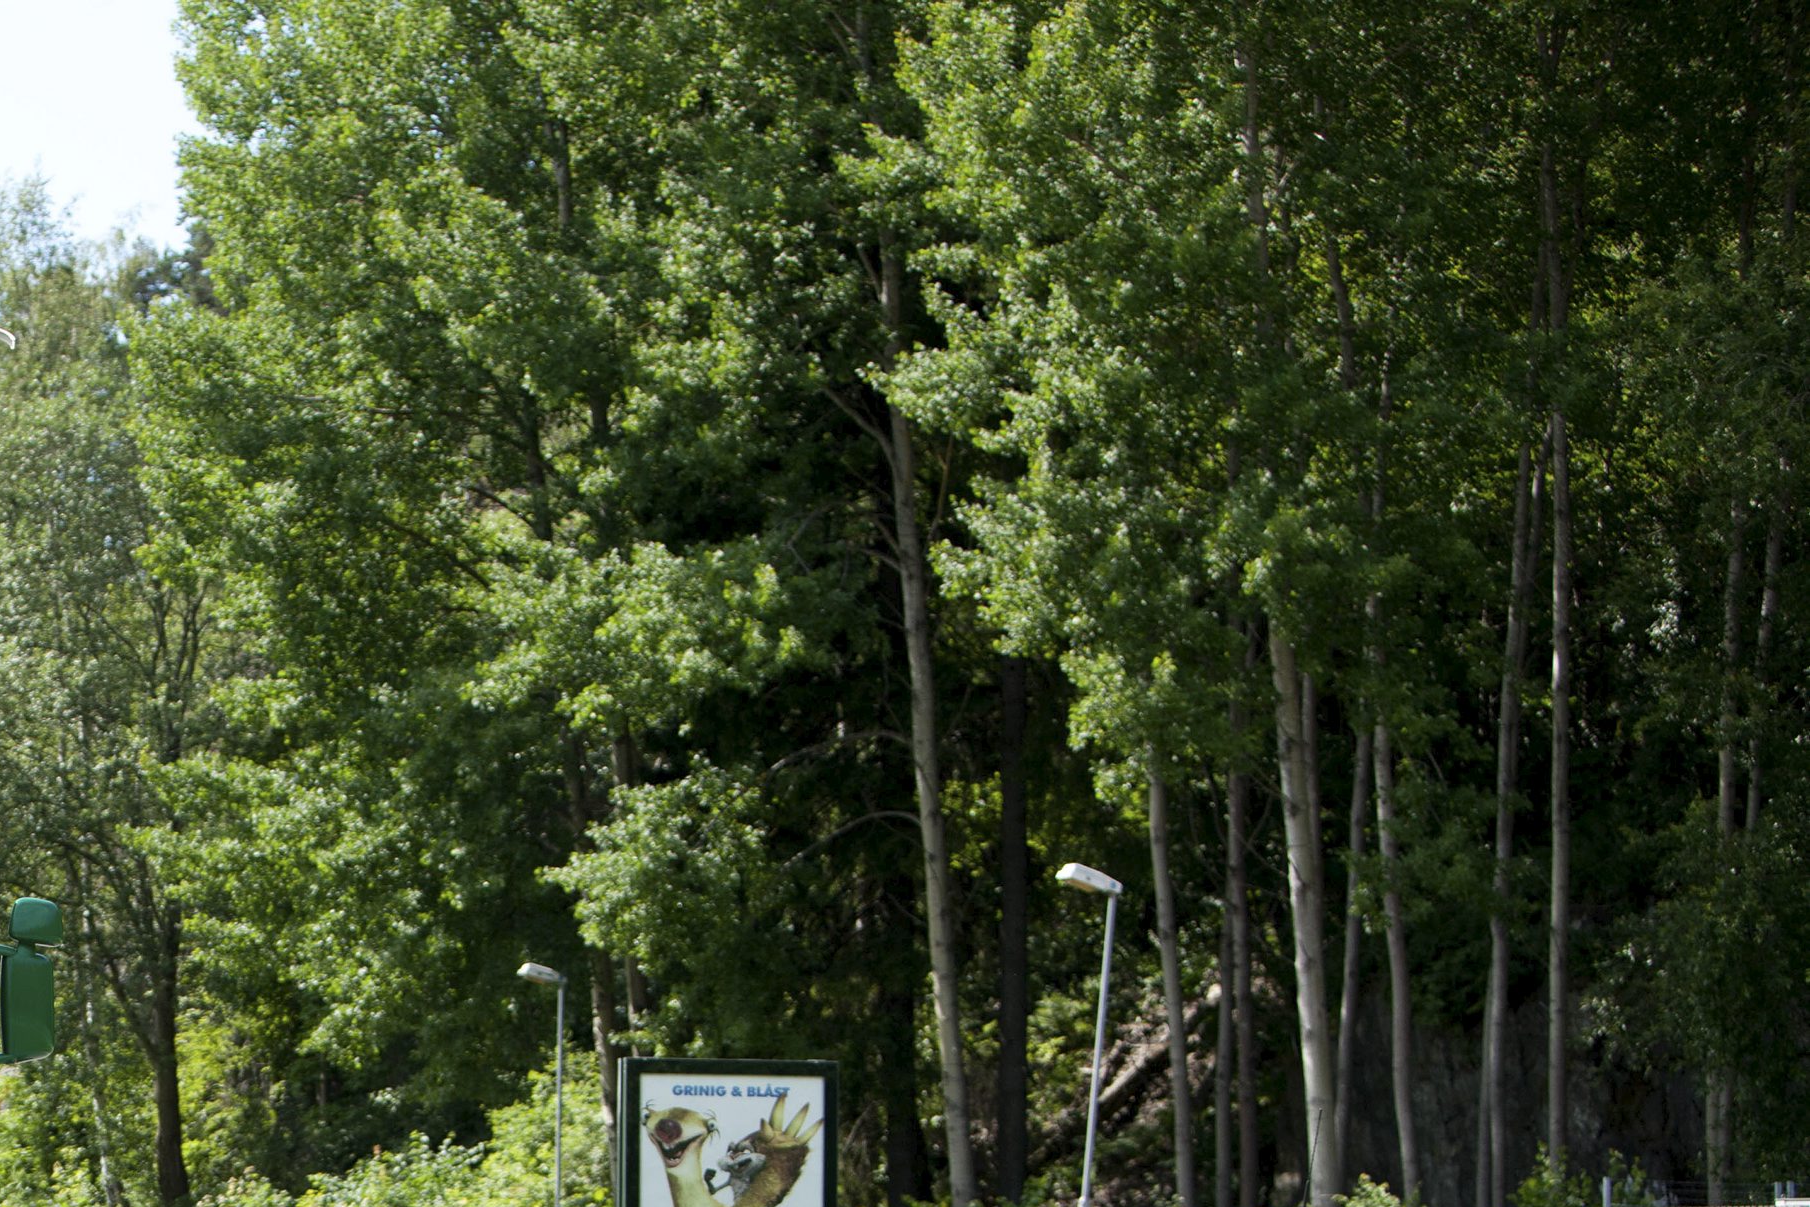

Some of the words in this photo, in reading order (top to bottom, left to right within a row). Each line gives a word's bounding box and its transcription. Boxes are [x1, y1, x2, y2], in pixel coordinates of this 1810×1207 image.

[672, 1084, 726, 1097] GRINIG
[731, 1085, 743, 1098] &
[747, 1083, 790, 1098] BLÅST
